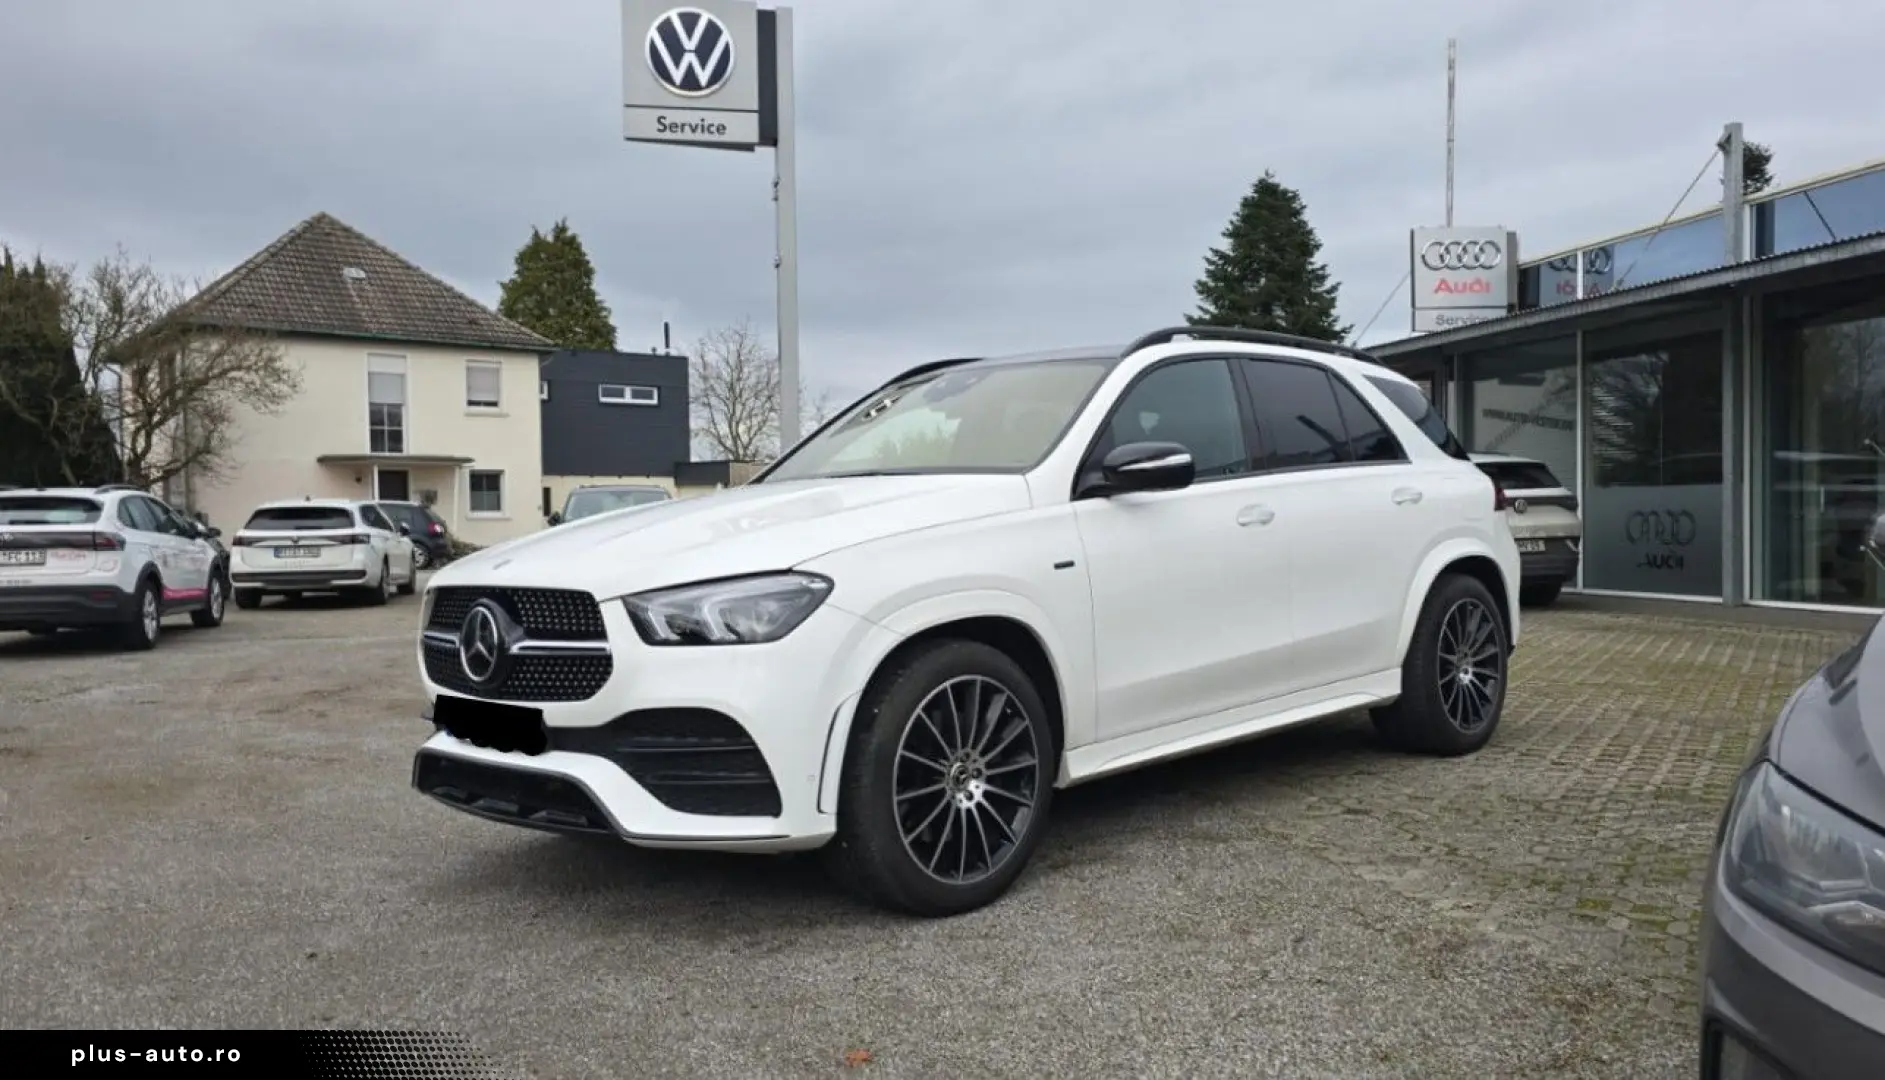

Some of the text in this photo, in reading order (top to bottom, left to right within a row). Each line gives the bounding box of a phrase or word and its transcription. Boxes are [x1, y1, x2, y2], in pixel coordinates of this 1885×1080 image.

[649, 11, 732, 90] VW
[656, 115, 727, 136] Service
[1434, 277, 1491, 294] Audi
